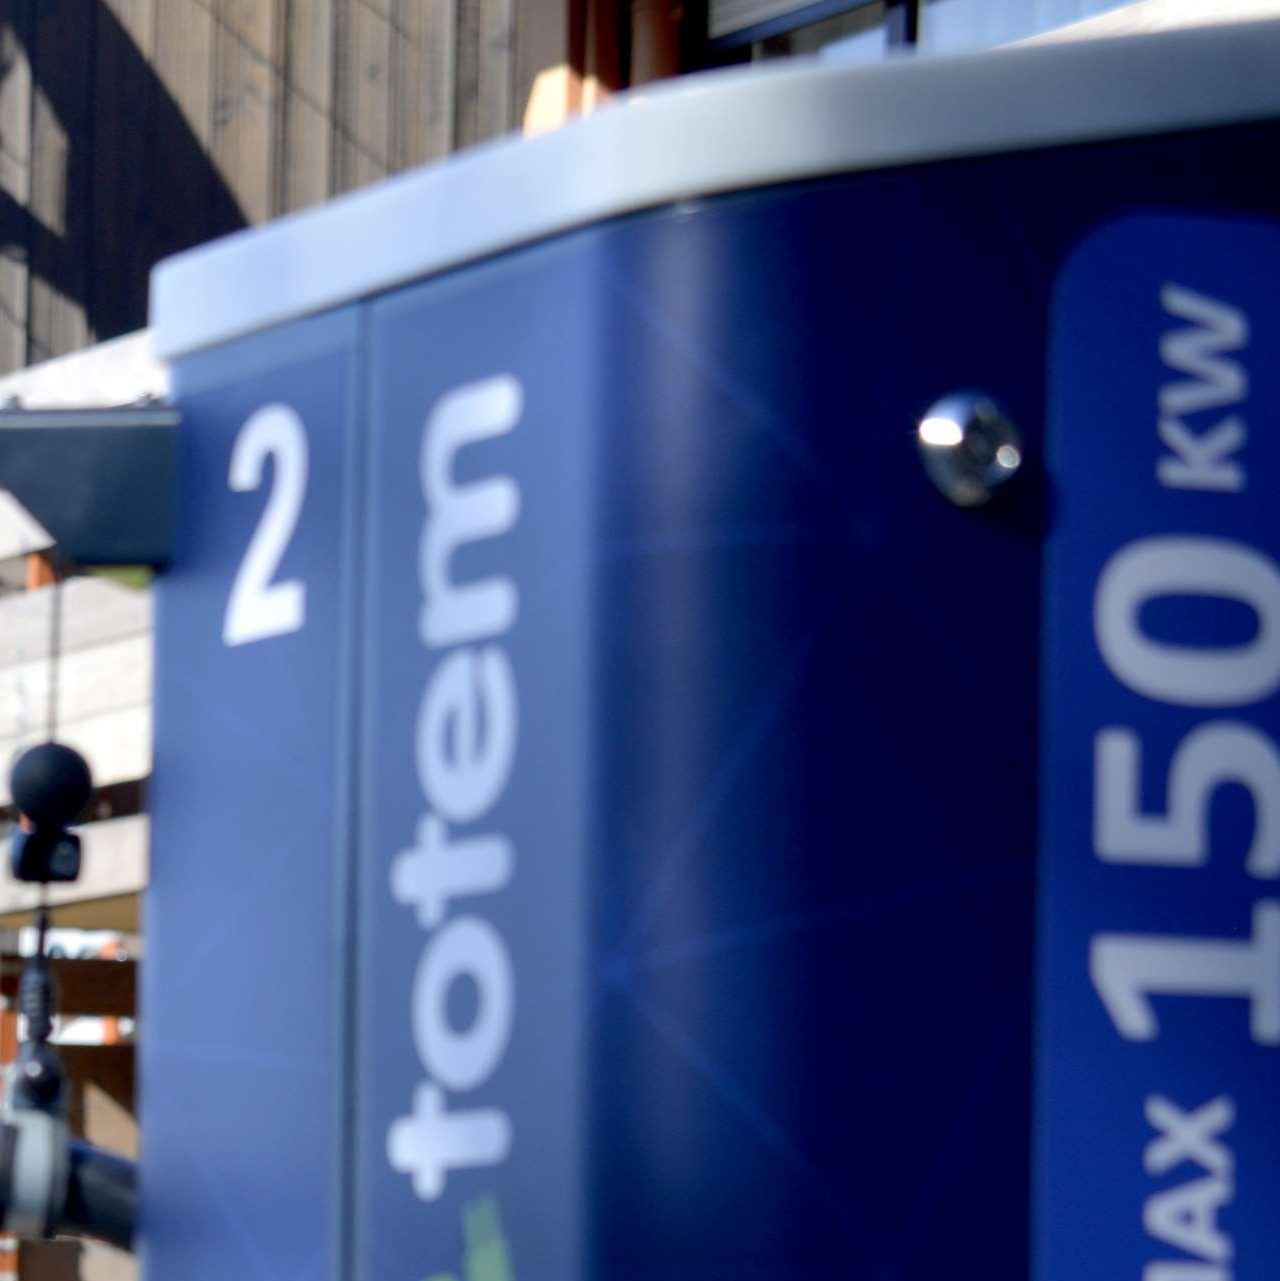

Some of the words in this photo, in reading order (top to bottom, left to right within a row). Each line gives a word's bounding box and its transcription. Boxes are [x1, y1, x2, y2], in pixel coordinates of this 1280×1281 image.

[1156, 282, 1249, 492] KW
[223, 402, 310, 648] 2
[1091, 534, 1280, 1046] 150
